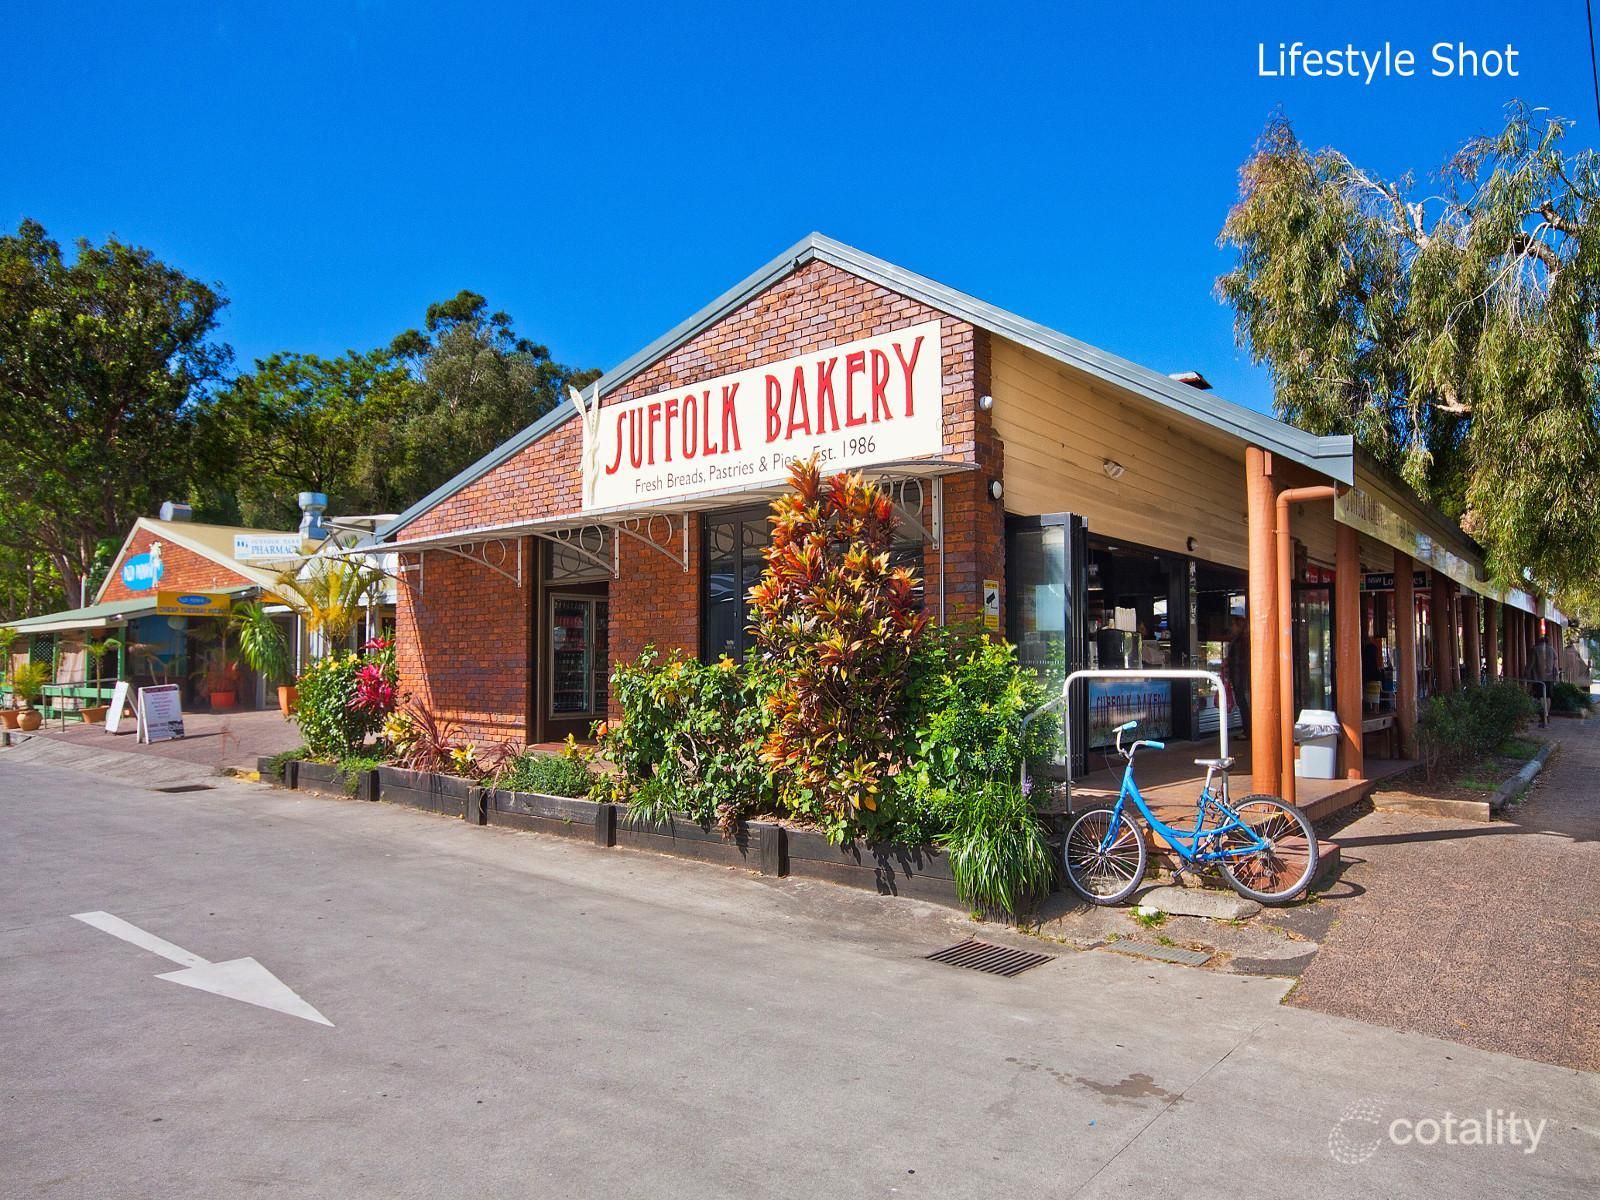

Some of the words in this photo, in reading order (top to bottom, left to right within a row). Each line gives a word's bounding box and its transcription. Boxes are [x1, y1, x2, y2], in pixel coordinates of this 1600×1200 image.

[605, 382, 742, 476] SUFFOLK
[764, 335, 925, 444] BAKERY
[635, 474, 663, 494] Fresh
[667, 468, 706, 489] Breads,
[709, 460, 755, 481] Pastries
[758, 455, 768, 472] &
[843, 435, 876, 458] 1986
